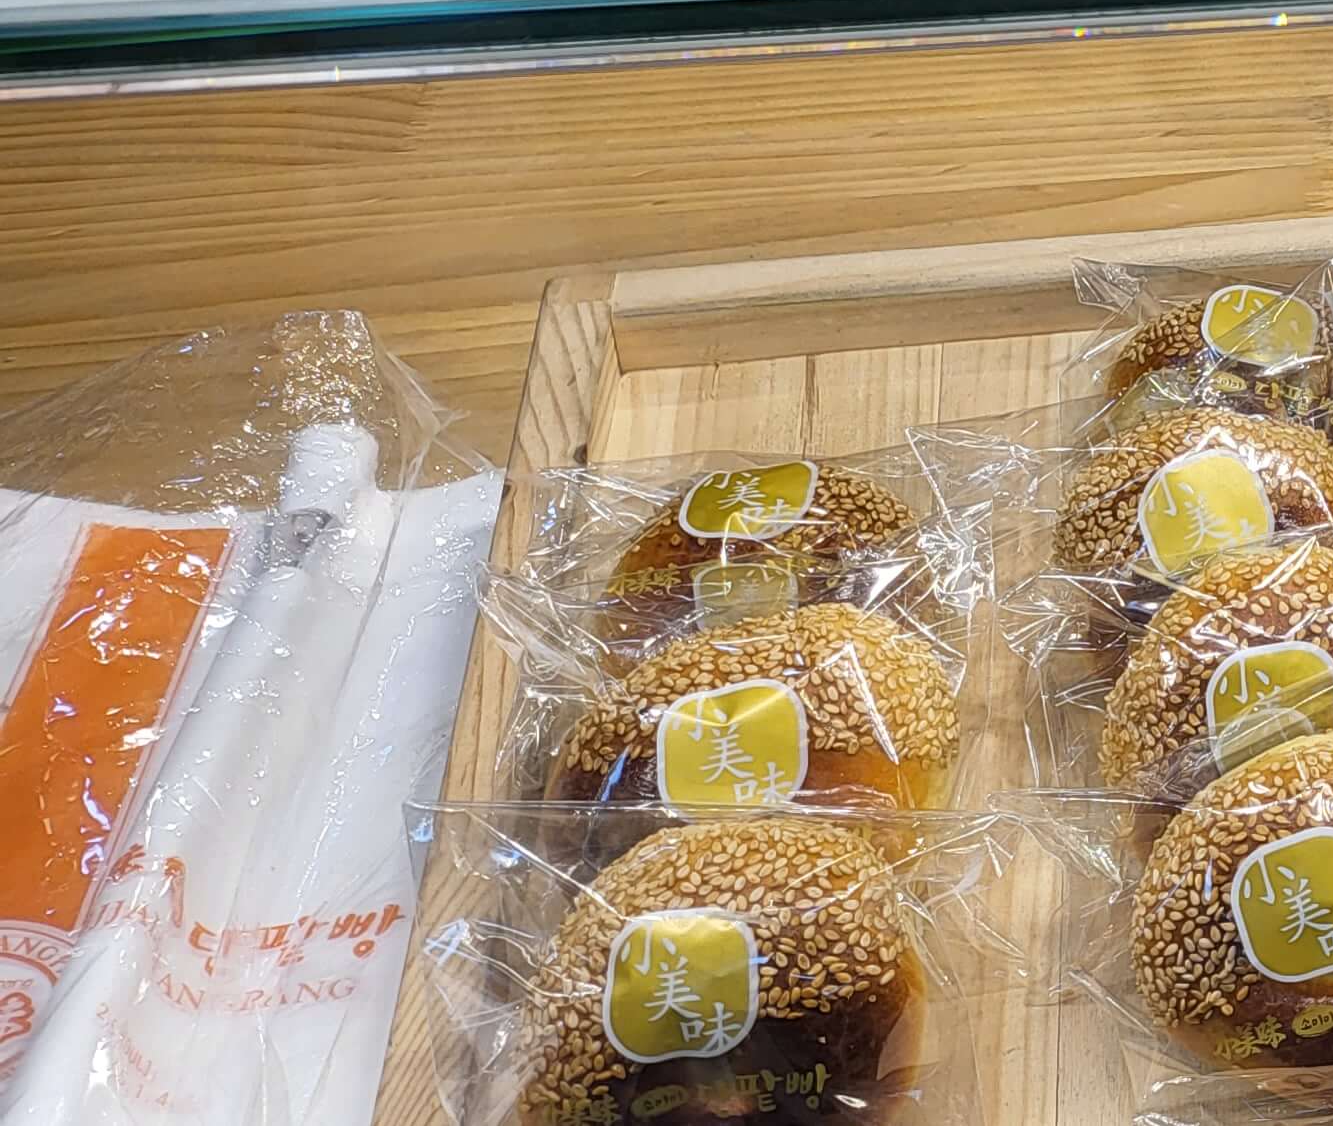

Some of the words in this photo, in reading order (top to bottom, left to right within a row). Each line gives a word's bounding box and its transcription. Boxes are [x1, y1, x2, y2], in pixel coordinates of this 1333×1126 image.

[670, 691, 794, 805] 小美味
[619, 918, 743, 1051] 小美味
